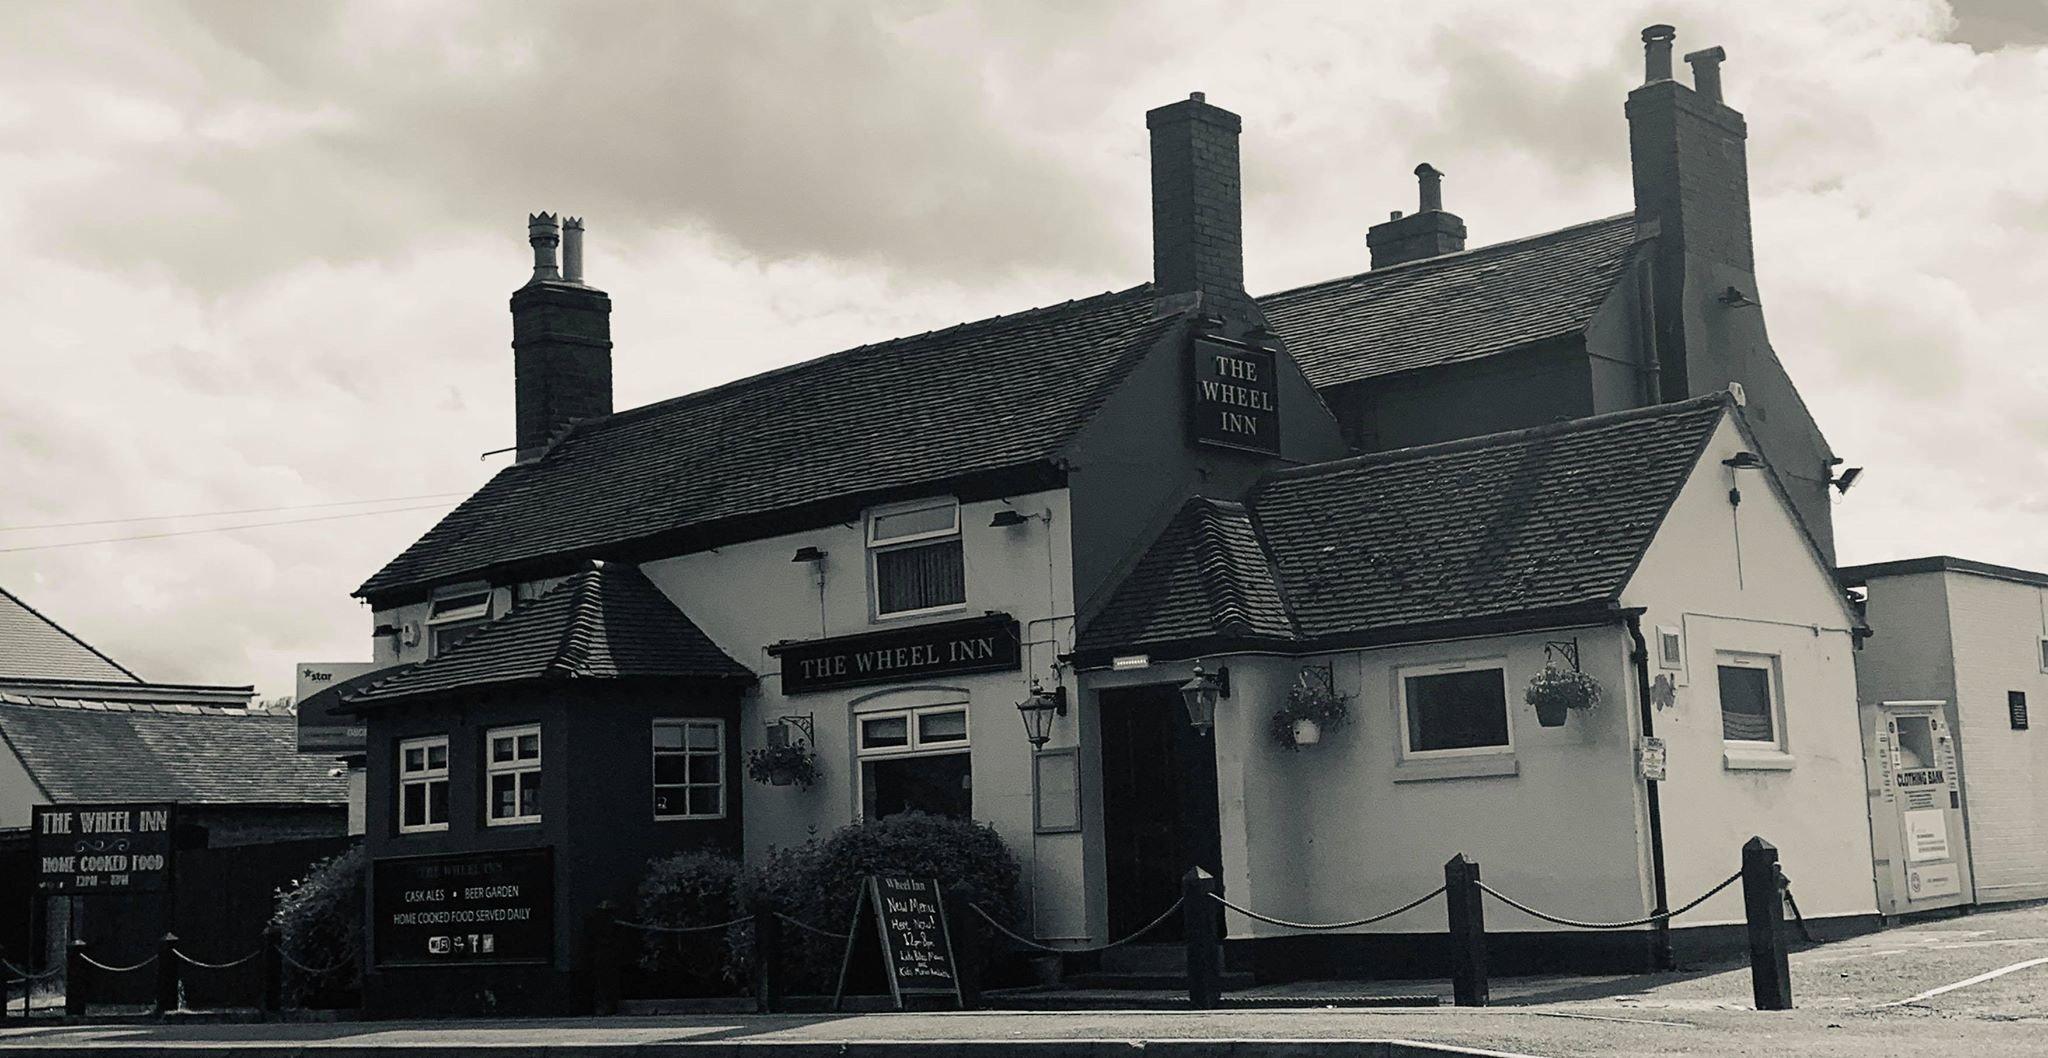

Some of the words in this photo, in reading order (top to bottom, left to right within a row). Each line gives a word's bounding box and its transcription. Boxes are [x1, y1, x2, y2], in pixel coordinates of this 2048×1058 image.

[1216, 355, 1257, 381] THE
[1202, 380, 1273, 411] WHEEL
[1221, 411, 1257, 435] INN
[800, 655, 847, 679] THE
[855, 644, 940, 673] WHEEL
[949, 637, 994, 662] INN
[311, 672, 332, 681] star
[1896, 771, 1927, 788] CLOTHING
[1927, 770, 1945, 785] BANK
[40, 812, 73, 834] THE
[79, 811, 132, 833] WHEEL
[139, 810, 168, 831] INN
[42, 856, 76, 873] HOME
[80, 855, 127, 872] COOKED
[132, 854, 164, 872] FOOD
[405, 890, 425, 902] CASK
[426, 889, 445, 901] ALES
[464, 887, 485, 900] BEER
[485, 885, 519, 899] GARDEN
[887, 897, 908, 913] New
[909, 898, 936, 914] Menu
[393, 913, 416, 925] HOME
[417, 912, 449, 924] COOKED
[451, 910, 474, 923] FOOD
[476, 909, 506, 922] SERVED
[507, 907, 531, 921] DAILY
